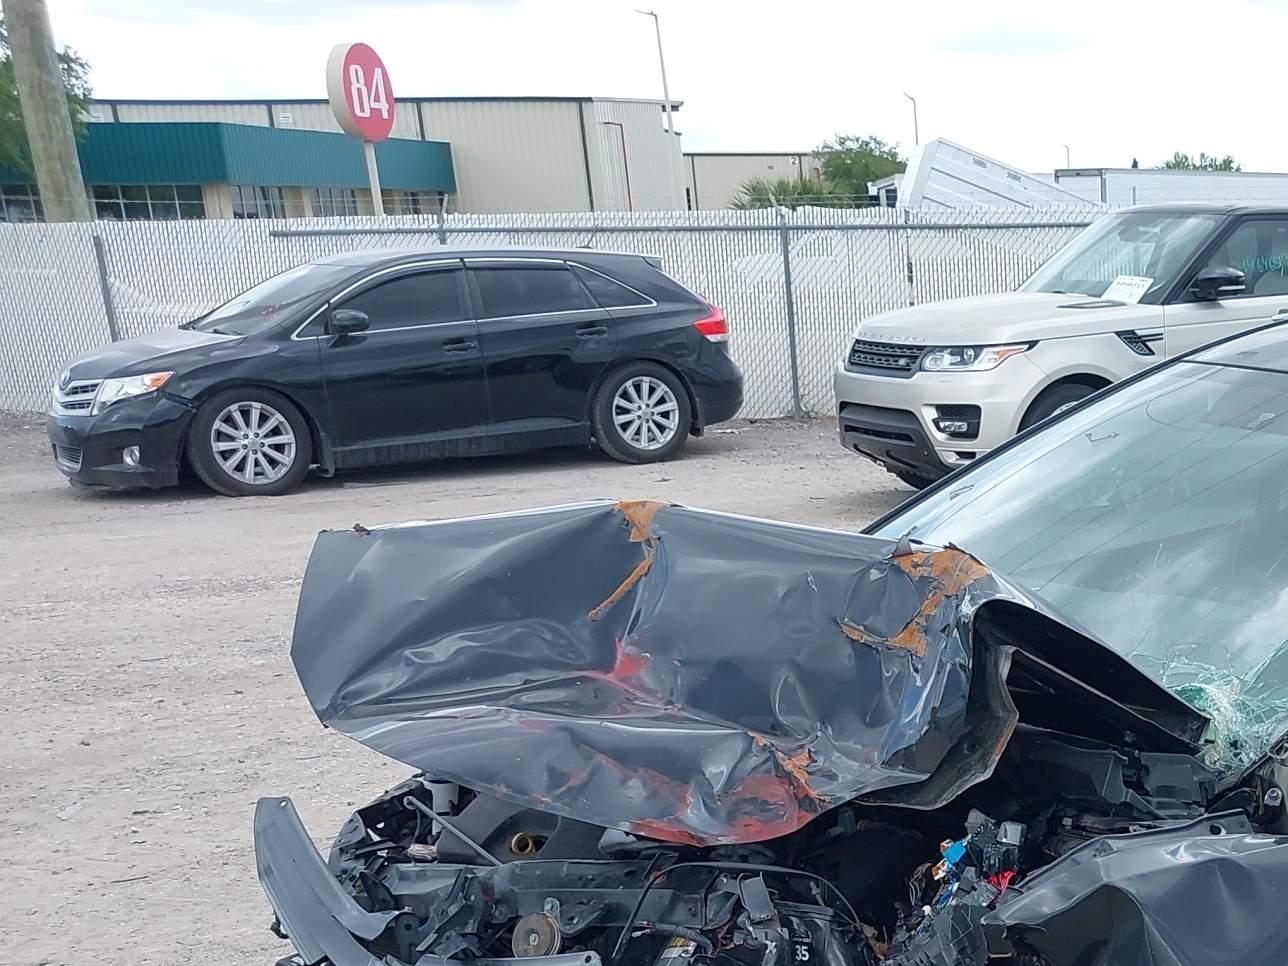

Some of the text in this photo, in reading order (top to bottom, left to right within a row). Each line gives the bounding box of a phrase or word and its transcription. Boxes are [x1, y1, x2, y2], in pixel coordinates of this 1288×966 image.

[349, 64, 389, 119] 84
[790, 156, 797, 165] 2
[795, 945, 810, 961] 35
